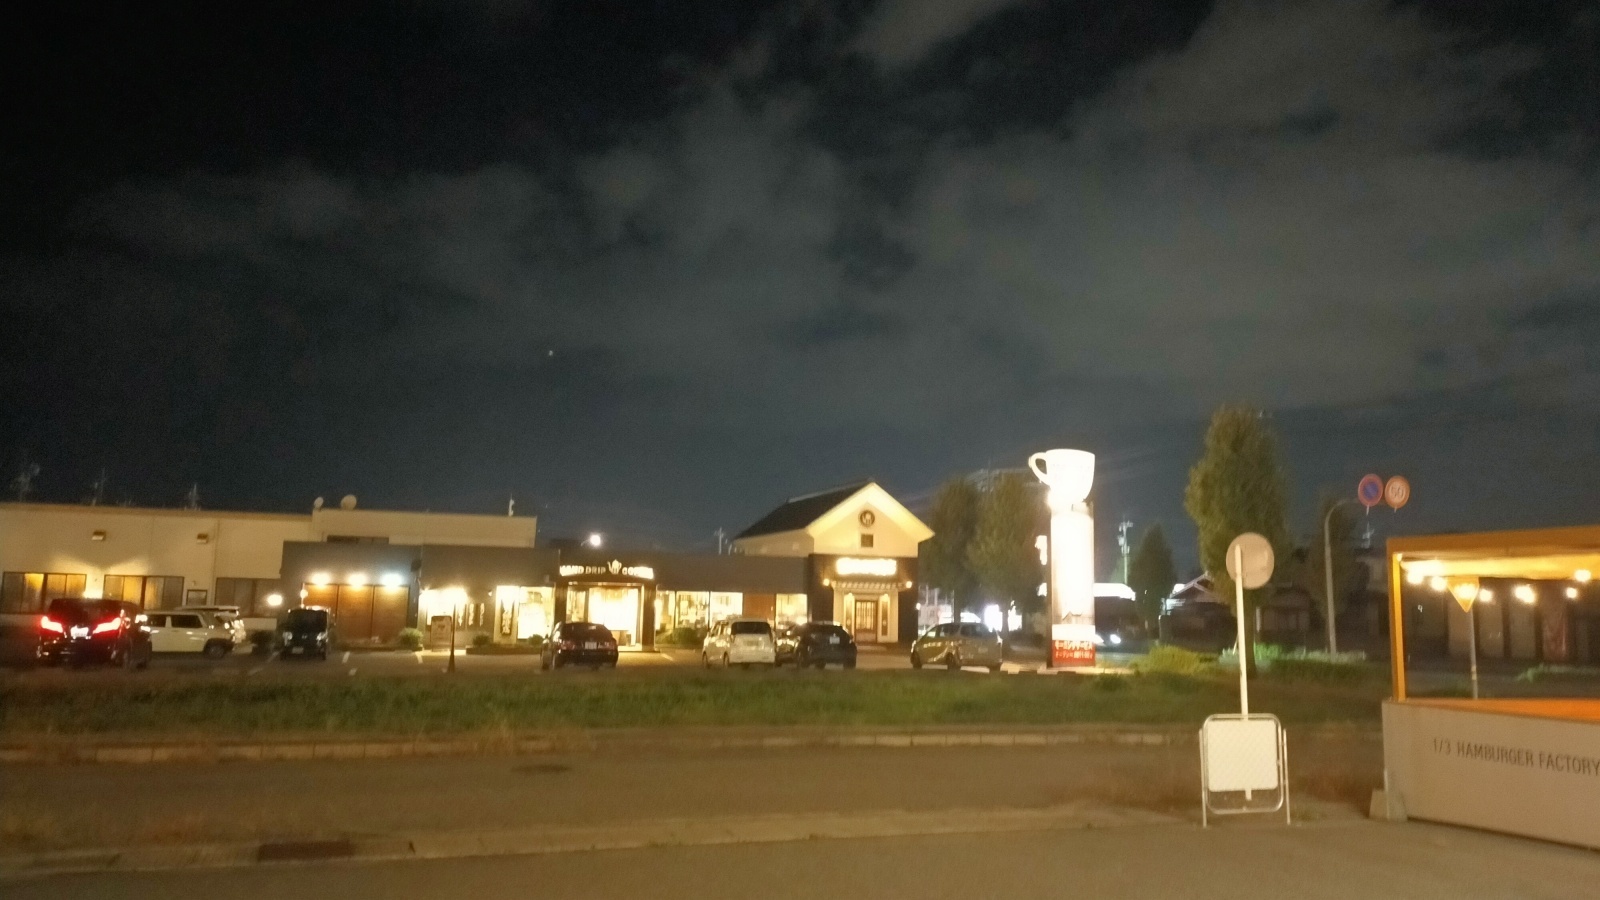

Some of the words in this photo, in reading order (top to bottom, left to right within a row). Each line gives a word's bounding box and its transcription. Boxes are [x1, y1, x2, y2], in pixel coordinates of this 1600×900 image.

[585, 566, 606, 575] DRIP
[1433, 738, 1450, 755] 1/3
[1457, 741, 1534, 767] HAMBURGER
[1539, 751, 1600, 776] FACTORY
